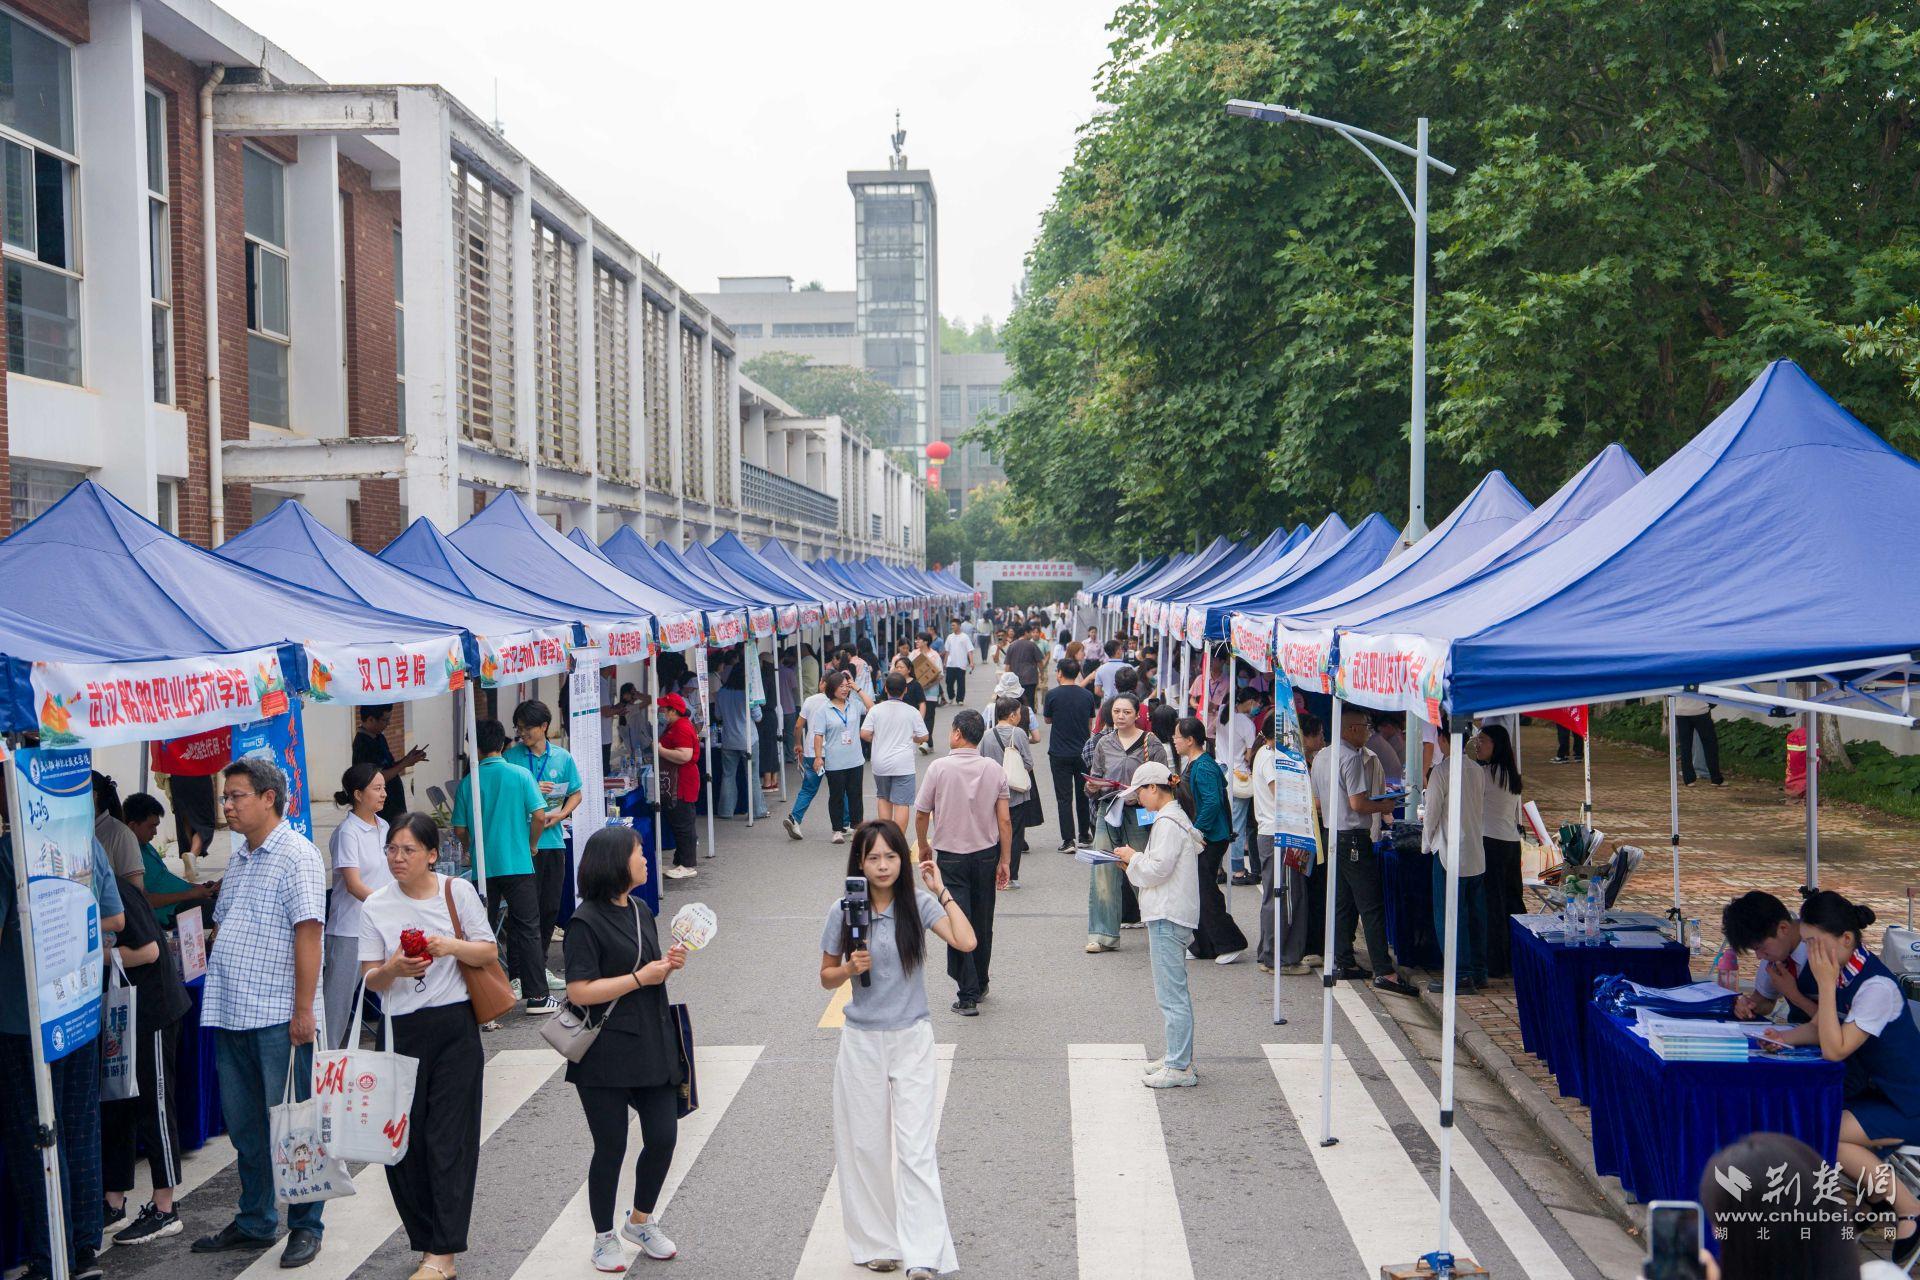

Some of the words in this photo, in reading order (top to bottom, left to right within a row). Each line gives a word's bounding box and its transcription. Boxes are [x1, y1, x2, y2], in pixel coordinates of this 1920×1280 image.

[358, 654, 426, 691] 汉口学院
[1353, 650, 1427, 699] 武汉职业技术大学
[86, 668, 252, 728] 武汉船舶职业技术学院
